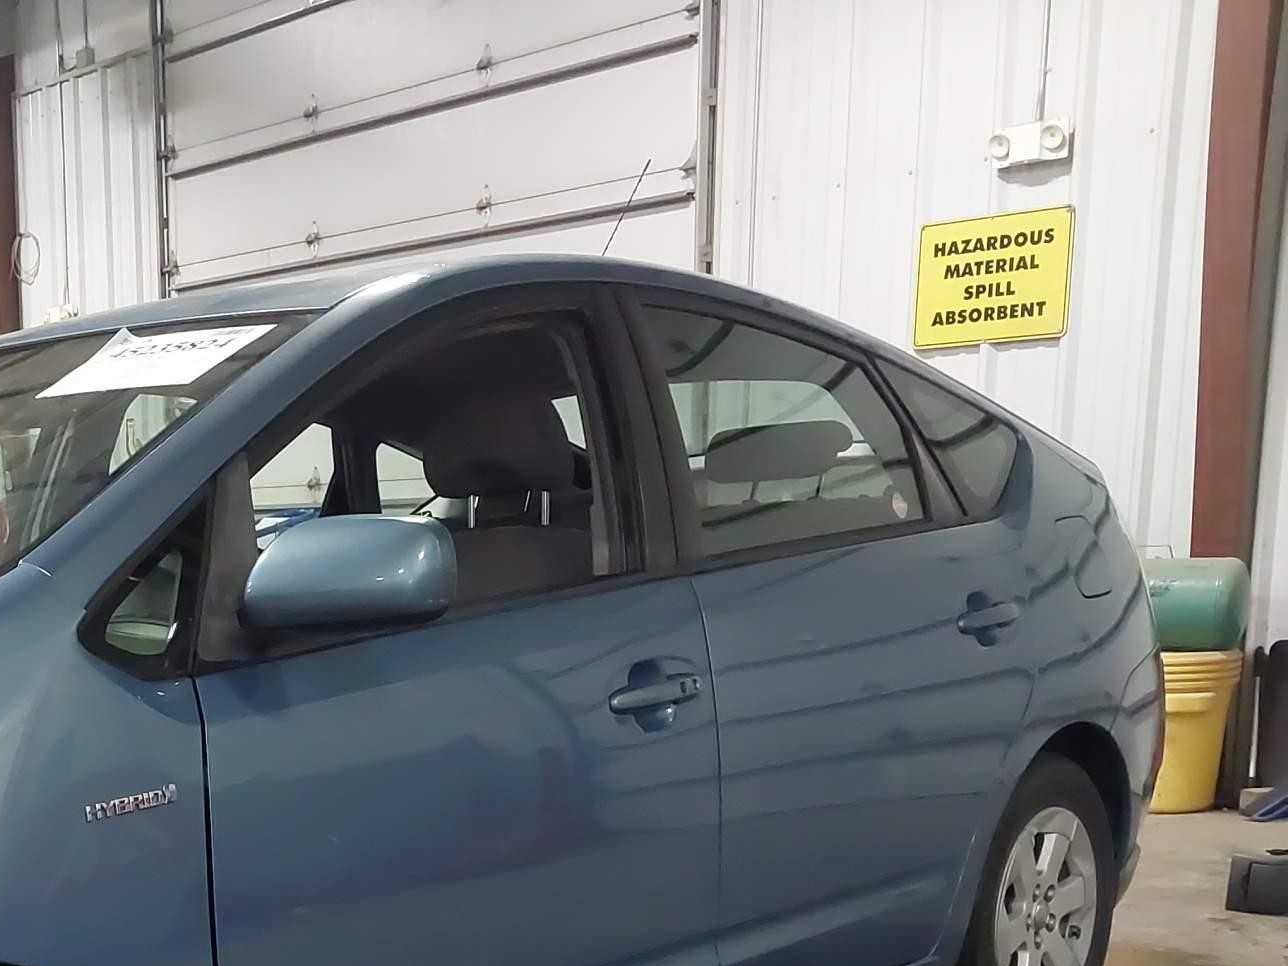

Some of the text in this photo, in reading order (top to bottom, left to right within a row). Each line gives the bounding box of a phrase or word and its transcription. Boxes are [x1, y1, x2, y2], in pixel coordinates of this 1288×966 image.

[933, 228, 1055, 258] HAZARDOUS
[944, 254, 1040, 279] MATERIAL
[963, 281, 1015, 300] SPILL
[931, 301, 1047, 327] ABSORBENT
[110, 337, 237, 359] 45235824
[85, 789, 166, 823] HYBRID
